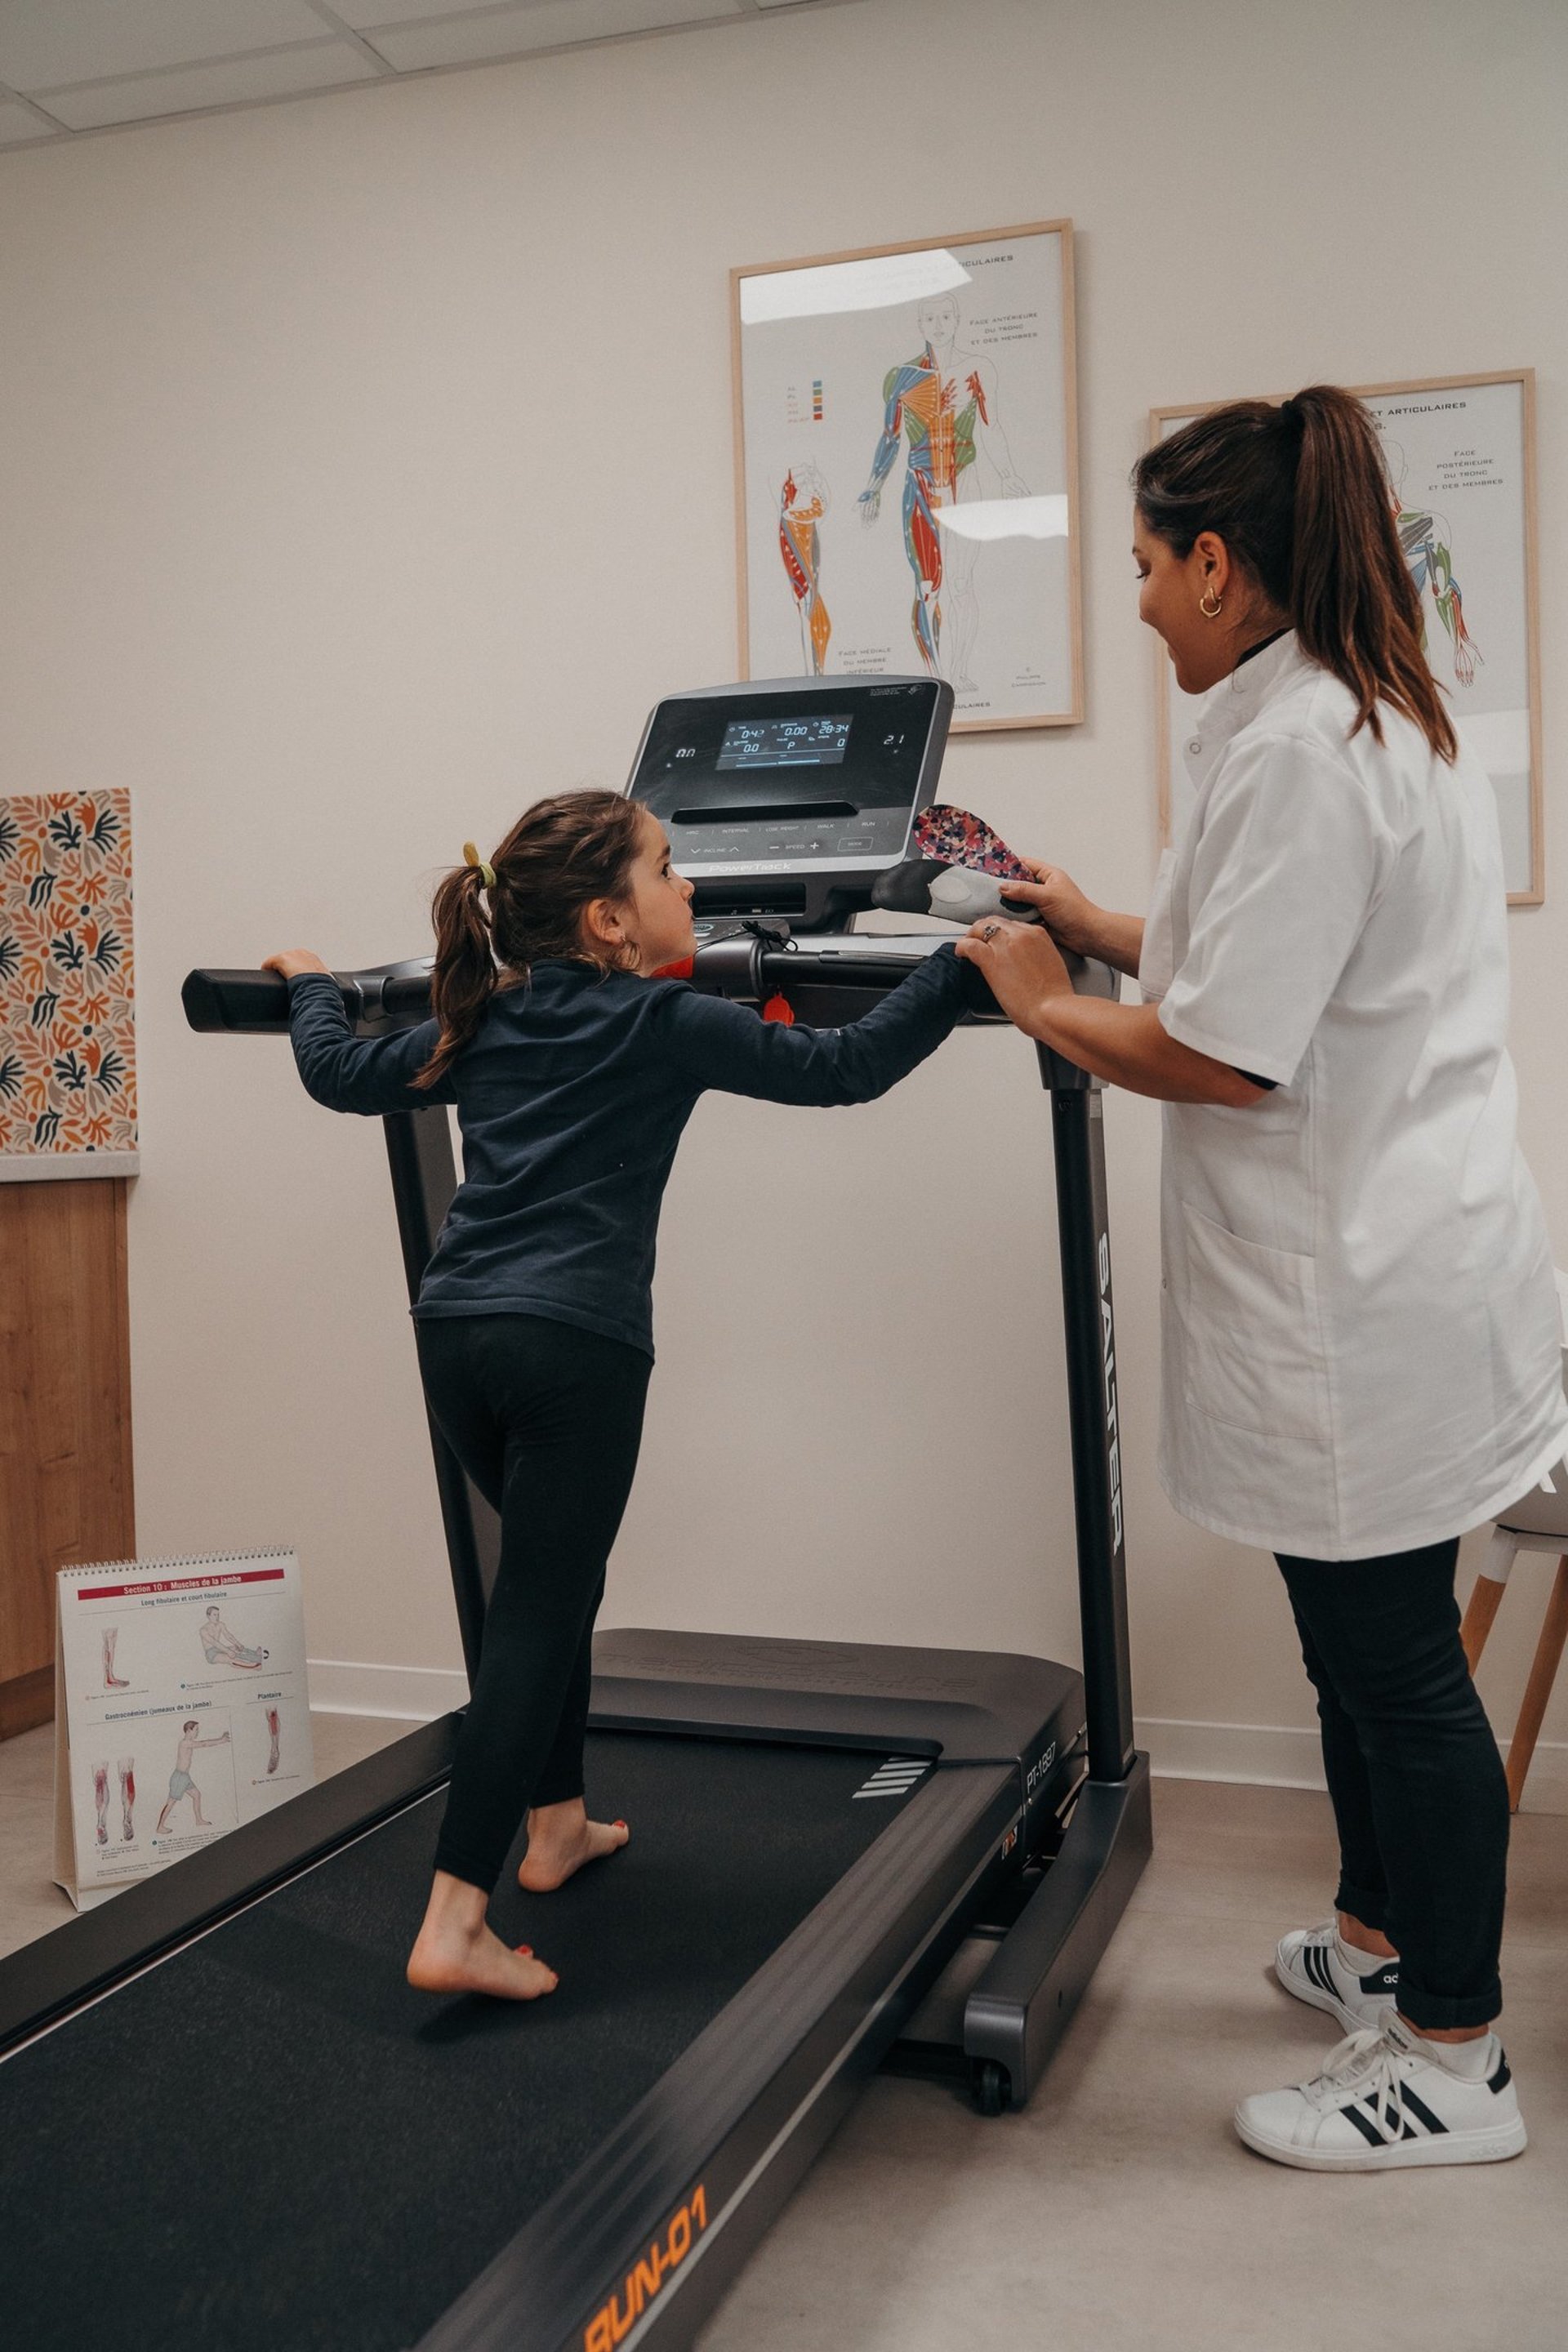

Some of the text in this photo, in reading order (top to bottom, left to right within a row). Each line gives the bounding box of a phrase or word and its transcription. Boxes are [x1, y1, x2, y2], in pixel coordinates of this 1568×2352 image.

[1388, 402, 1467, 416] ARTICULAIRES
[1463, 479, 1503, 488] MEMBRES
[784, 726, 808, 736] 0.00
[818, 724, 849, 734] 28:34
[1098, 1232, 1122, 1556] SALTER
[124, 1584, 150, 1595] Section
[154, 1583, 163, 1591] 10
[170, 1579, 200, 1590] Muscles
[202, 1578, 211, 1586] de
[212, 1576, 220, 1585] la
[220, 1575, 242, 1587] jambe
[140, 1598, 155, 1607] Long
[257, 1691, 282, 1699] Plantaire
[105, 1708, 149, 1721] Gastrocnémien
[192, 1699, 212, 1710] jambe)
[1027, 1741, 1056, 1794] PT-1897
